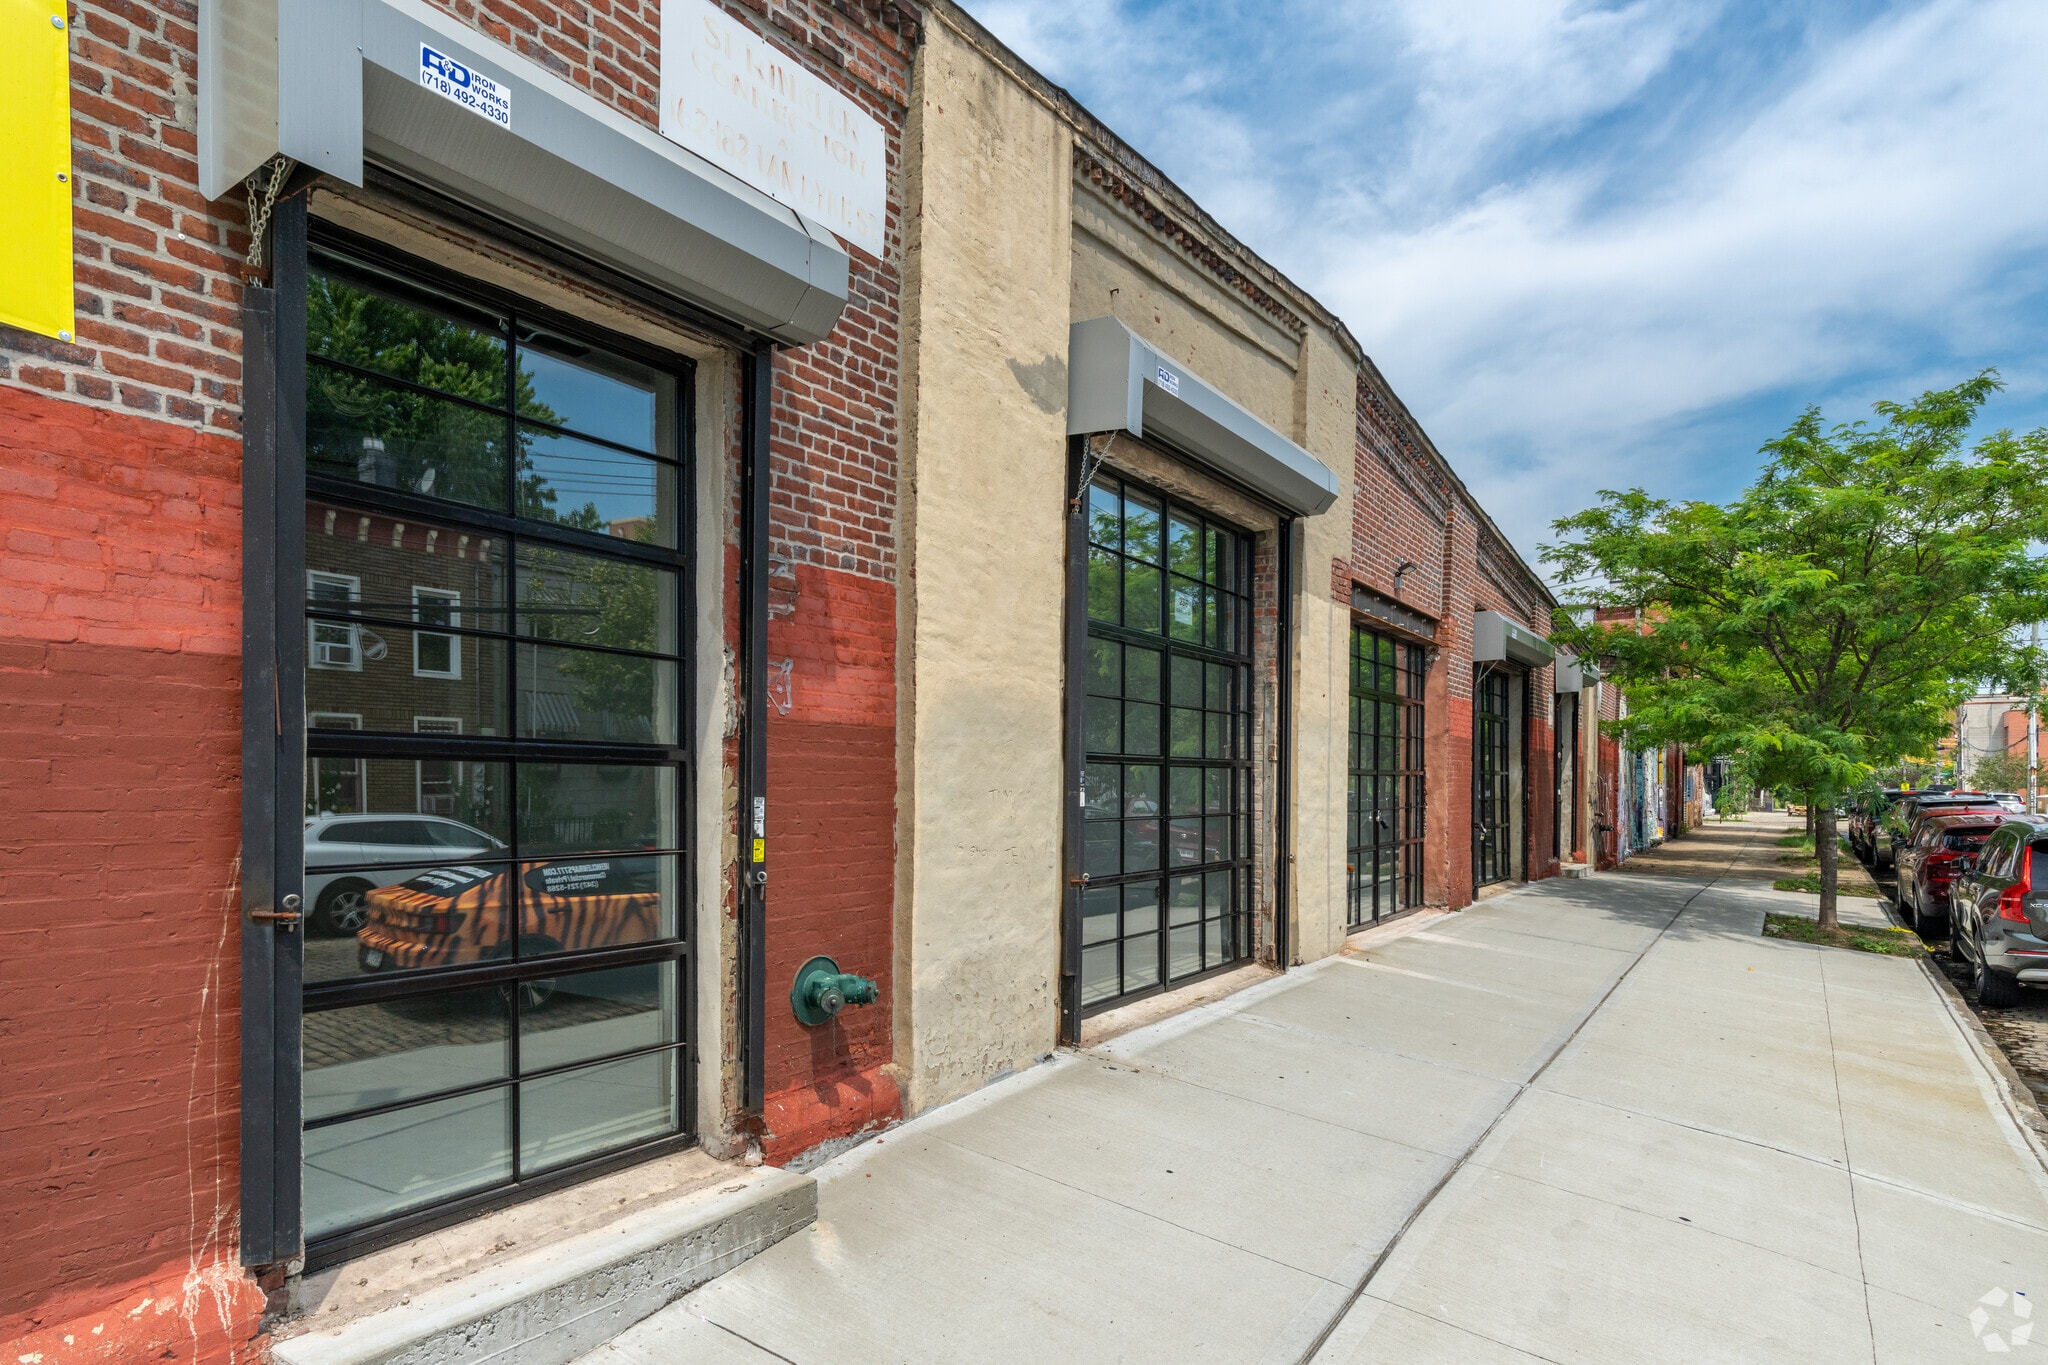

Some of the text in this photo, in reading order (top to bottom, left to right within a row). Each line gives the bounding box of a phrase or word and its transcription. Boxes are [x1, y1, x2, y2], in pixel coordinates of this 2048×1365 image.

[471, 72, 496, 93] IRON
[422, 70, 509, 125] (718) 492-4330
[471, 83, 509, 110] WORKS
